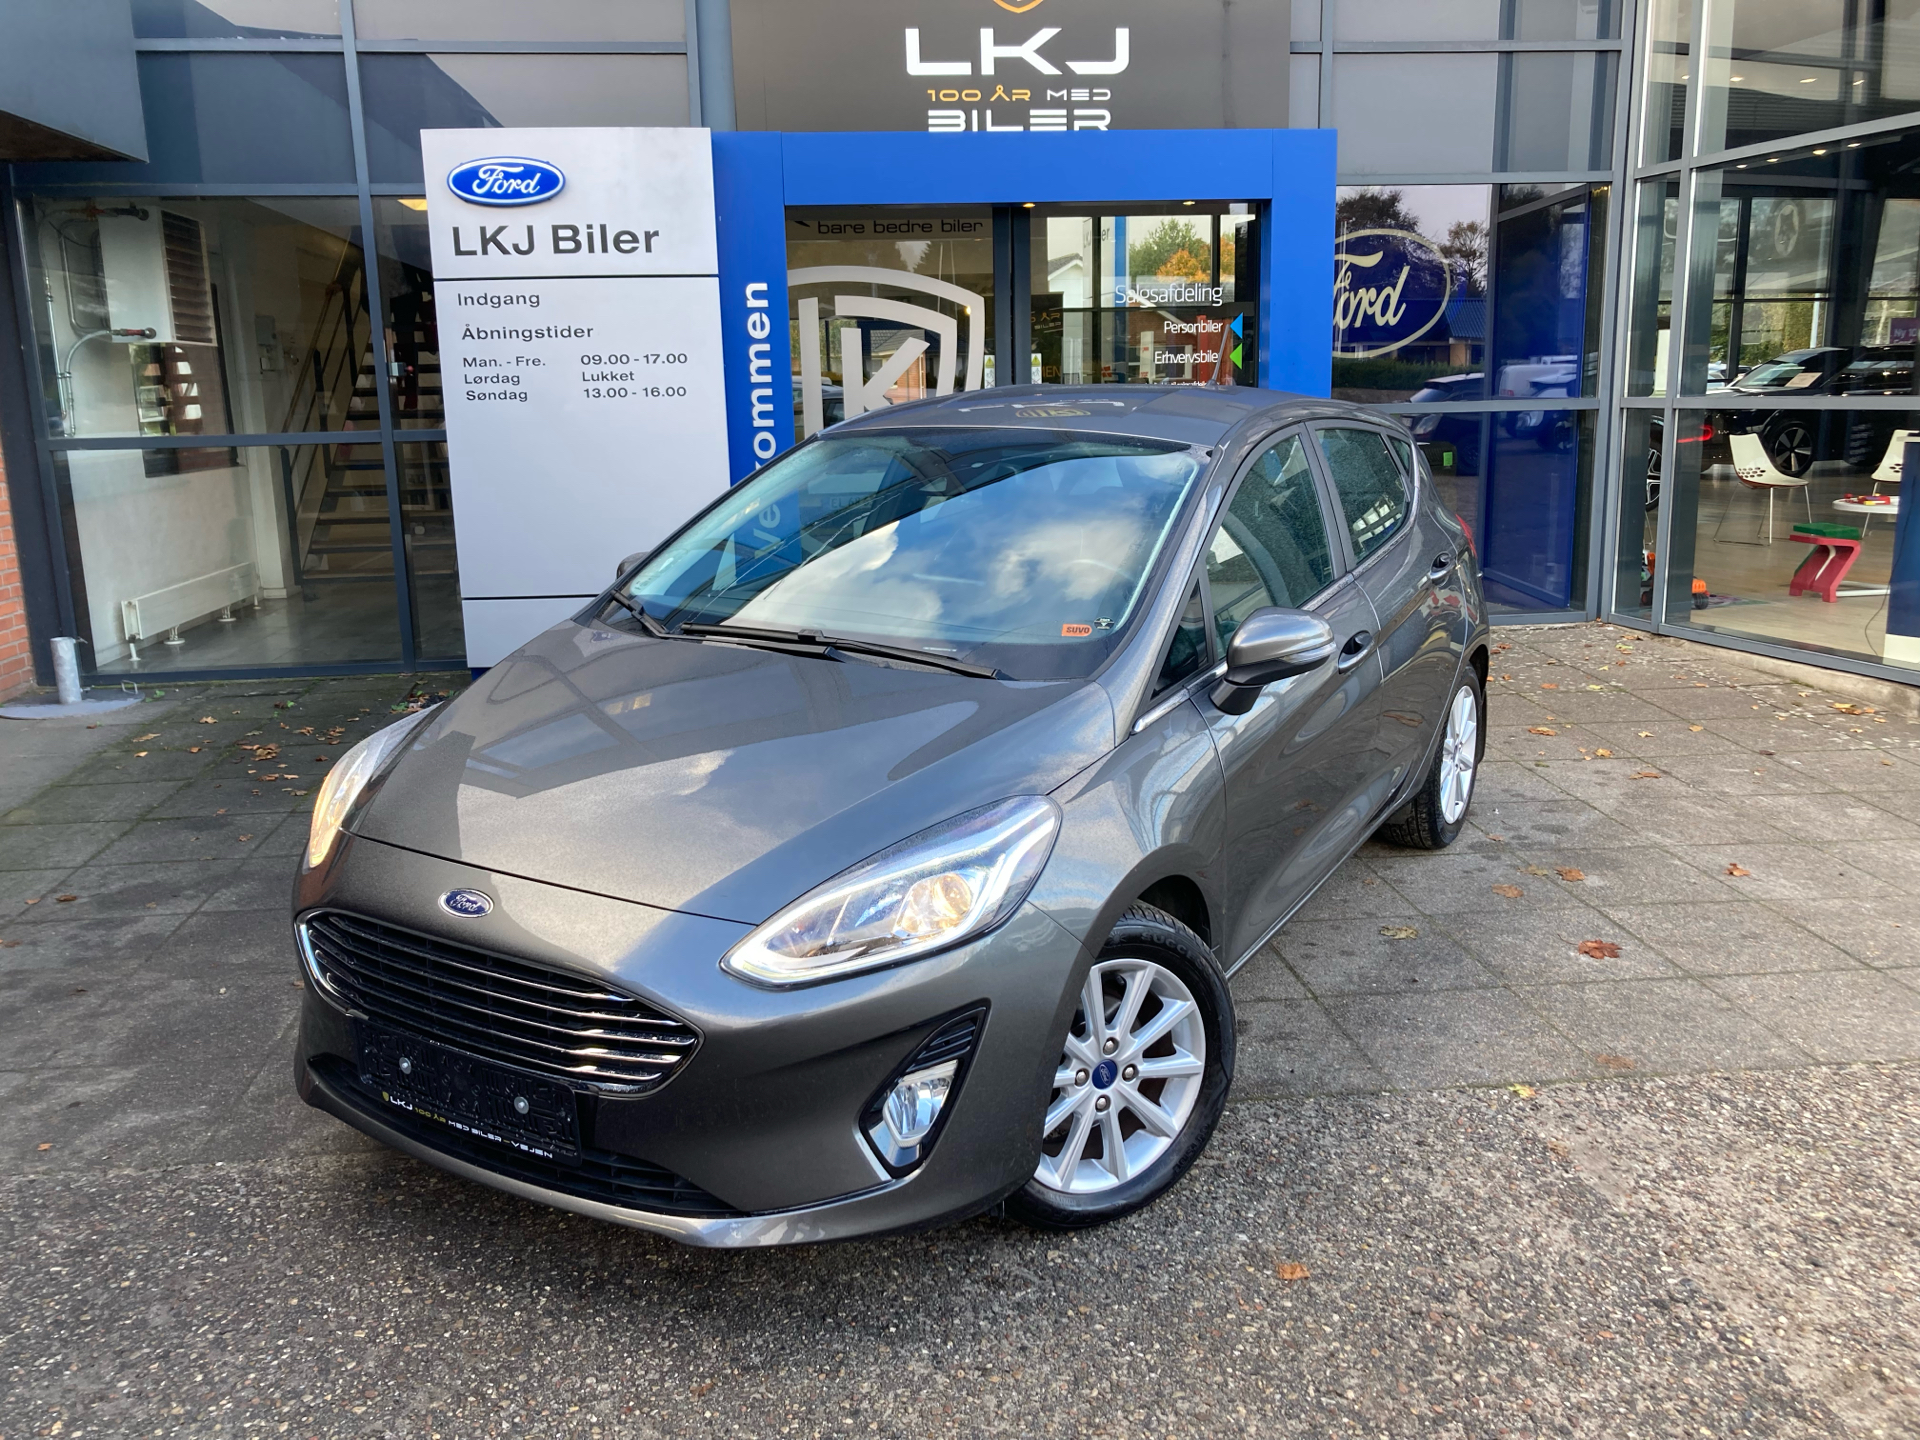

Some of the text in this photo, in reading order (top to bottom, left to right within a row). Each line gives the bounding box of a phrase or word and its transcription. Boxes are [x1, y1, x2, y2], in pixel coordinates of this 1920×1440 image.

[904, 26, 1130, 76] LKJ
[927, 84, 1111, 102] 100 ÅR MED
[927, 108, 1112, 132] BILER
[471, 164, 541, 194] Ford
[817, 218, 983, 235] bare bedre biler
[452, 223, 660, 256] LKJ Biler
[457, 293, 541, 308] Indgang
[1115, 282, 1224, 307] Salgsafdeling
[461, 324, 594, 342] Åbningstider
[1163, 320, 1224, 334] Personbiler
[462, 357, 503, 368] Man.
[515, 356, 546, 367] Fre.
[580, 354, 631, 366] 09.00
[643, 353, 688, 364] 17.00
[464, 371, 635, 386] Lørdag Lukket
[466, 390, 528, 402] Søndag
[583, 387, 628, 399] 13.00
[642, 386, 687, 397] 16.00
[1066, 626, 1090, 634] SUVO
[450, 893, 482, 912] Ford
[389, 1096, 413, 1111] LKJ
[414, 1107, 432, 1118] 100
[448, 1120, 470, 1132] MED
[471, 1127, 502, 1142] BILER
